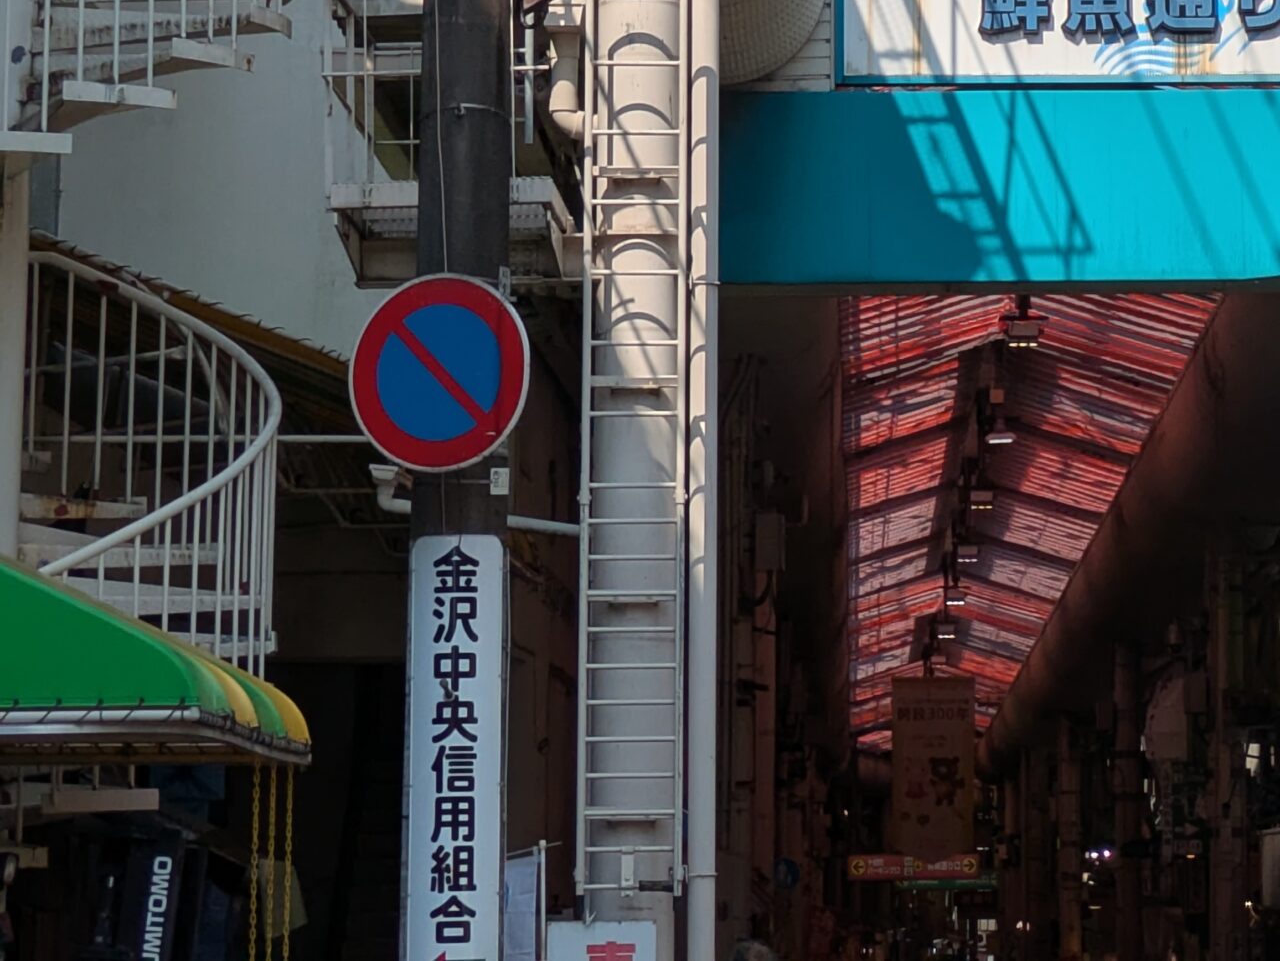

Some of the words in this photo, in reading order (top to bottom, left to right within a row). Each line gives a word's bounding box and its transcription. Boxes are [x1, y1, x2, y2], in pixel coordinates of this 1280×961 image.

[430, 545, 480, 943] 金沢中央信用組合
